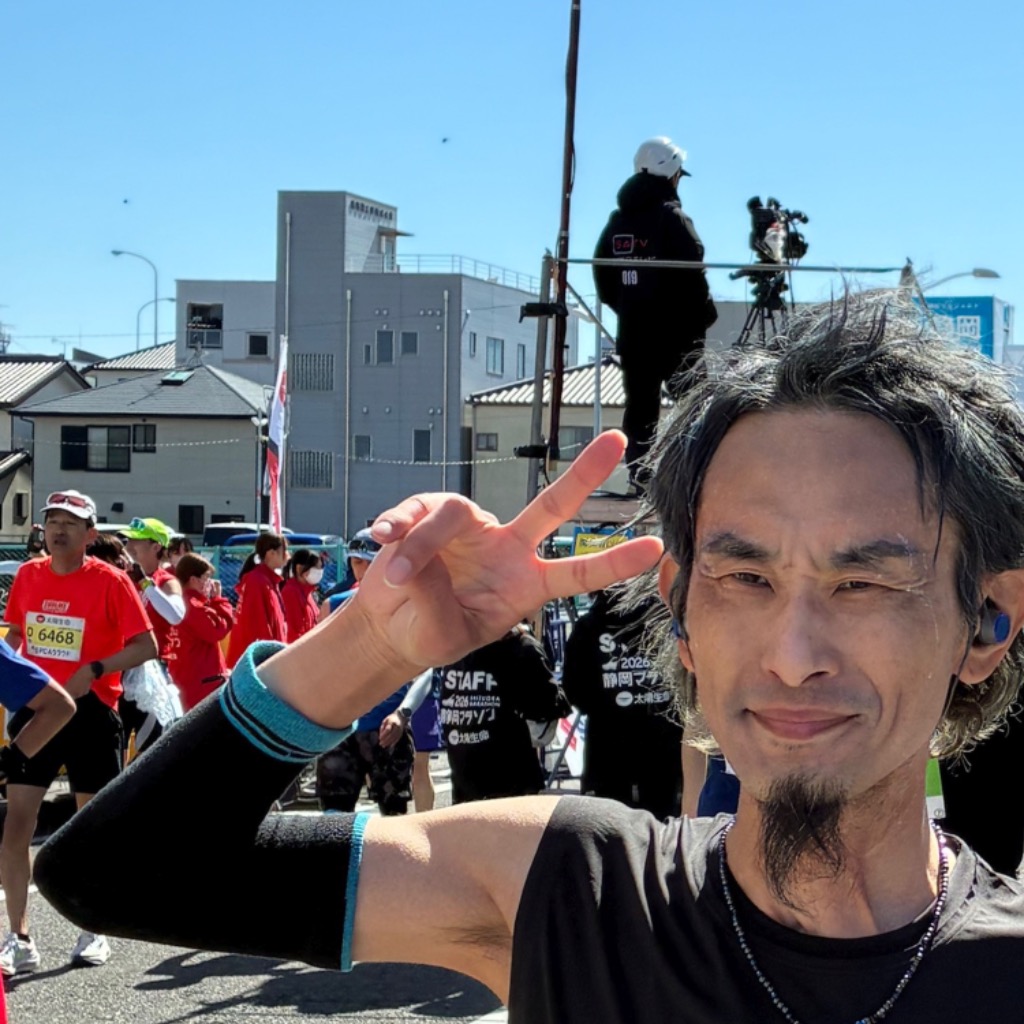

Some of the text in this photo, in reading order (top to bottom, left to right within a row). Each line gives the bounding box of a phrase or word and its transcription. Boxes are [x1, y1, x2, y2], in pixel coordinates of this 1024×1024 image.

[38, 628, 75, 645] 6468
[621, 657, 650, 669] 2026
[445, 670, 498, 691] STAFF
[602, 671, 659, 688] 静岡マラ
